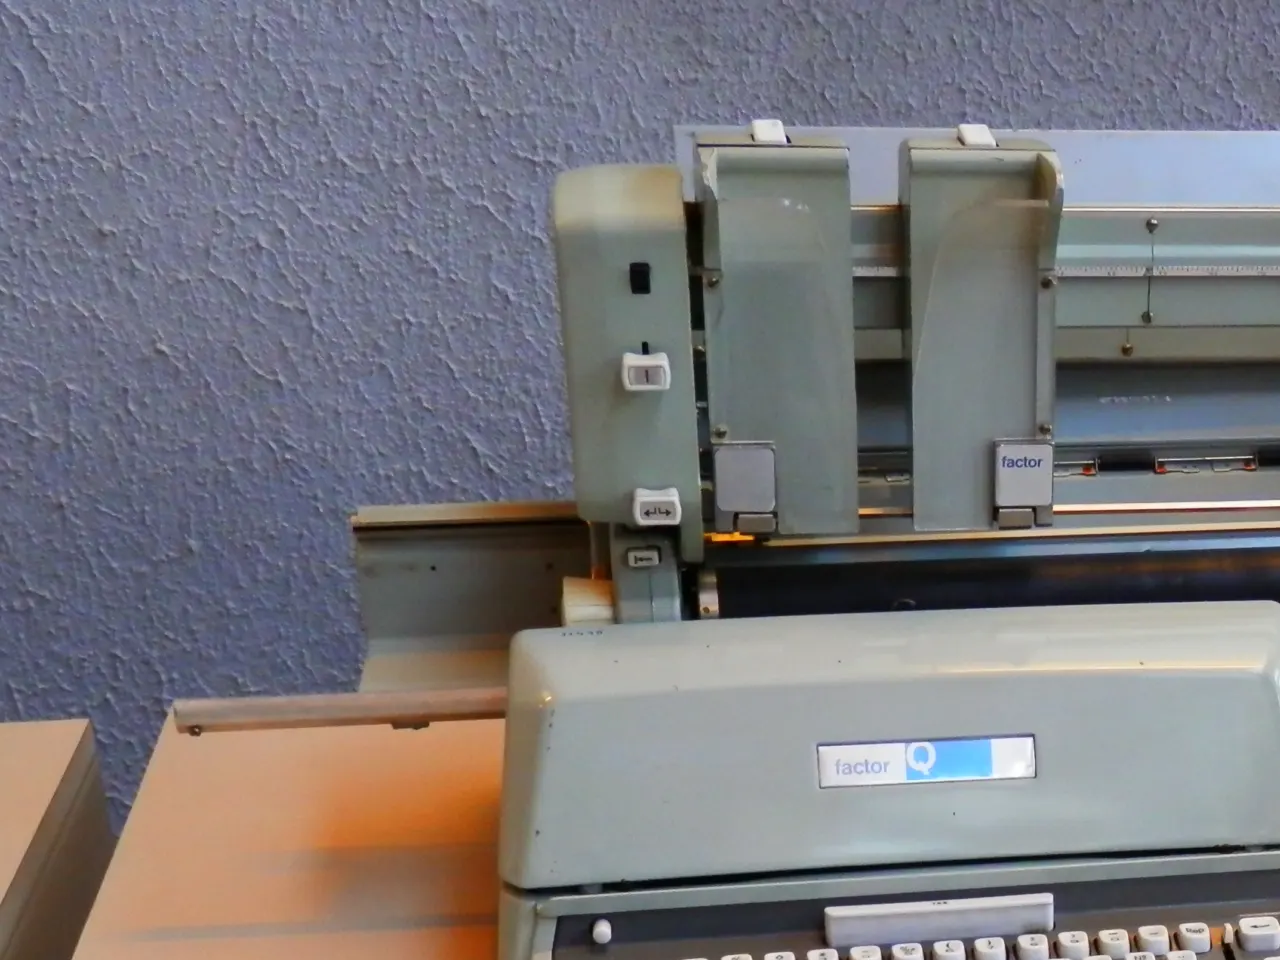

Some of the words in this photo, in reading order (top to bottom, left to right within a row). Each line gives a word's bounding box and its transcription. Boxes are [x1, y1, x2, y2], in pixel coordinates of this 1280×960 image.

[1001, 455, 1043, 469] factor
[835, 759, 890, 775] factor
[907, 741, 937, 776] Q
